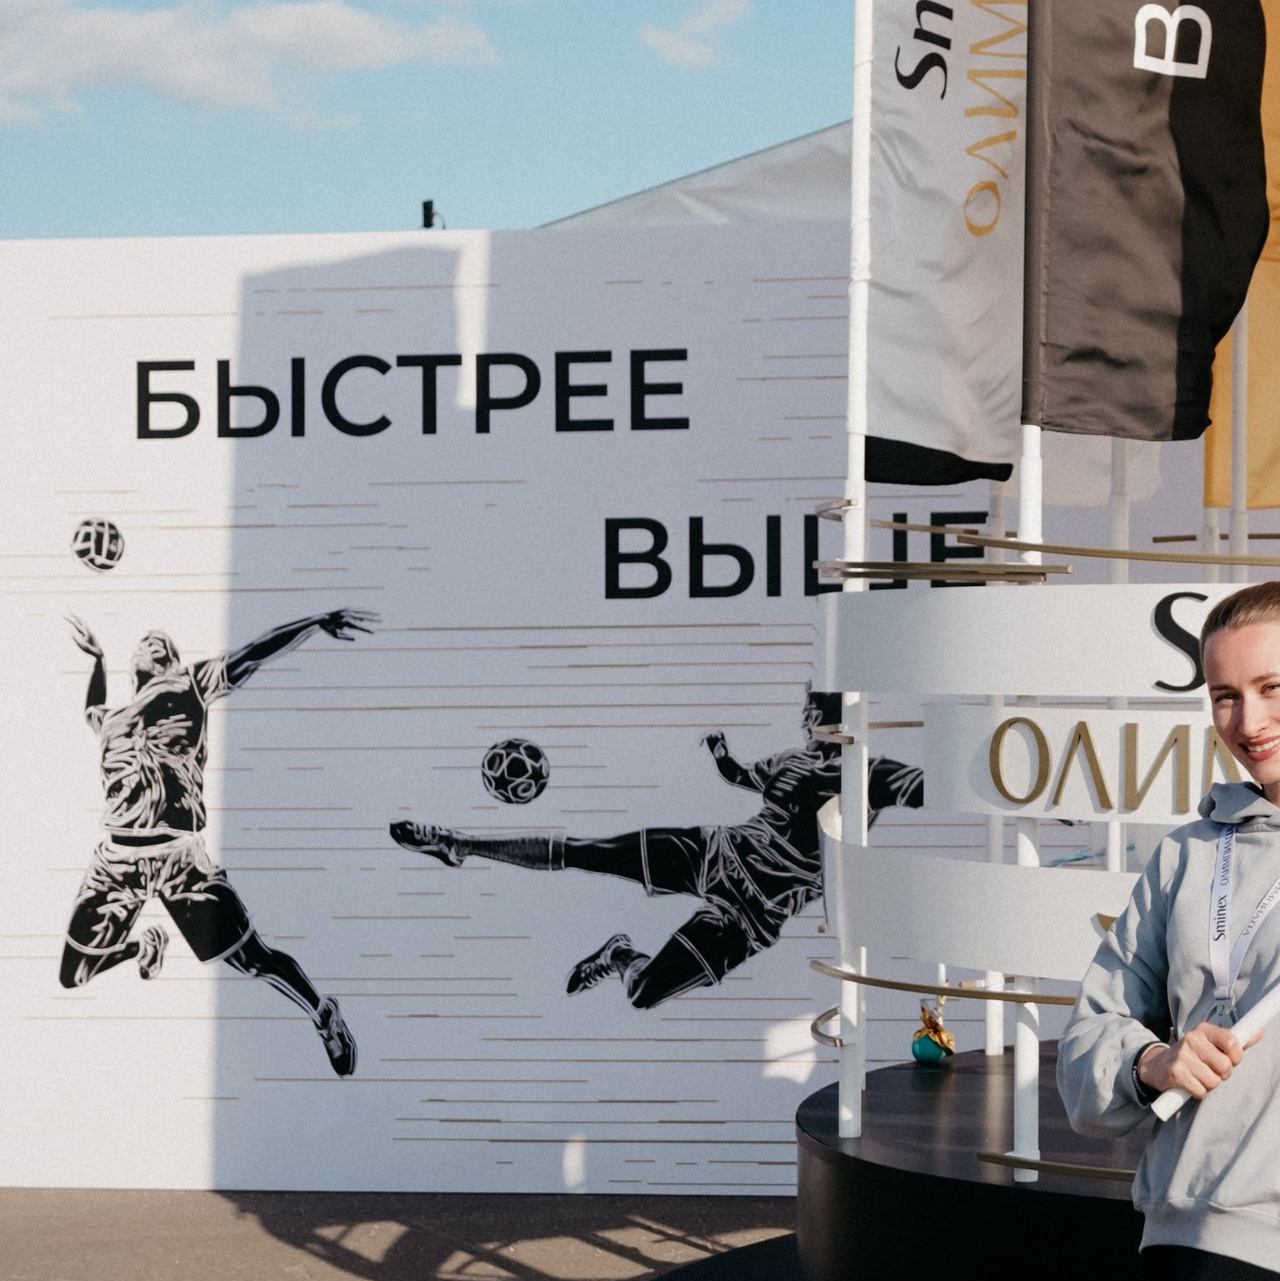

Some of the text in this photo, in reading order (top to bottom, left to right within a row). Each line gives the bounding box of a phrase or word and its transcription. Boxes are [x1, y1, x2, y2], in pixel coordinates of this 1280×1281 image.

[135, 347, 692, 440] БЫСТРЕЕ
[603, 511, 989, 600] ВЫШЕ
[1213, 894, 1228, 942] Sminex
